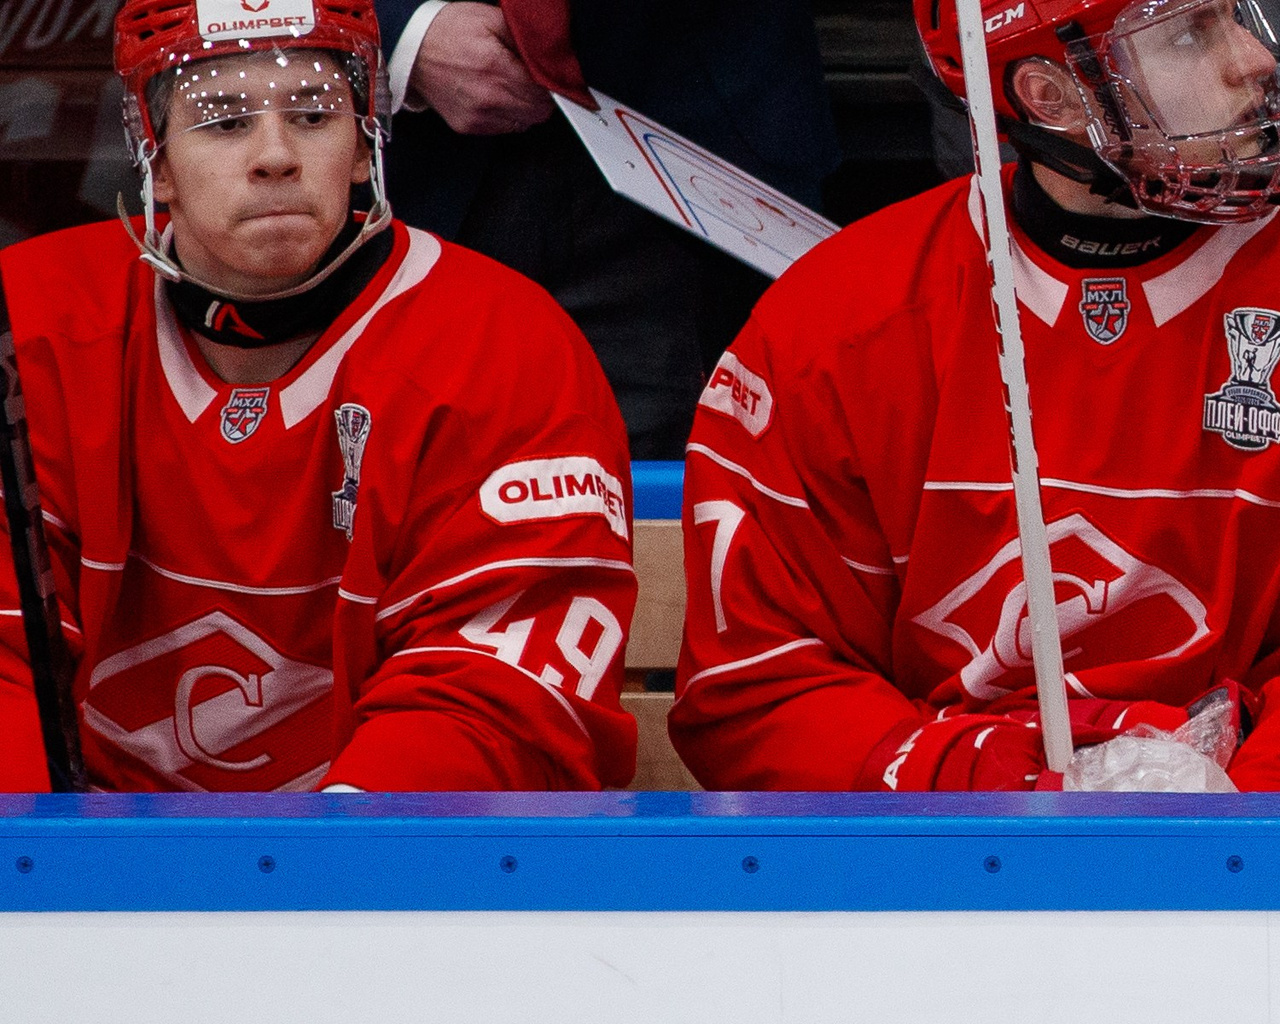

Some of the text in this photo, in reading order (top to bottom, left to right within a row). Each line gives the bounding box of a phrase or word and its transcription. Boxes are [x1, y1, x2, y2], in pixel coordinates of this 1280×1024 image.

[206, 16, 306, 34] OLIMPBET
[983, 2, 1025, 33] CM
[1087, 290, 1122, 303] МХЛ
[458, 588, 624, 701] 49
